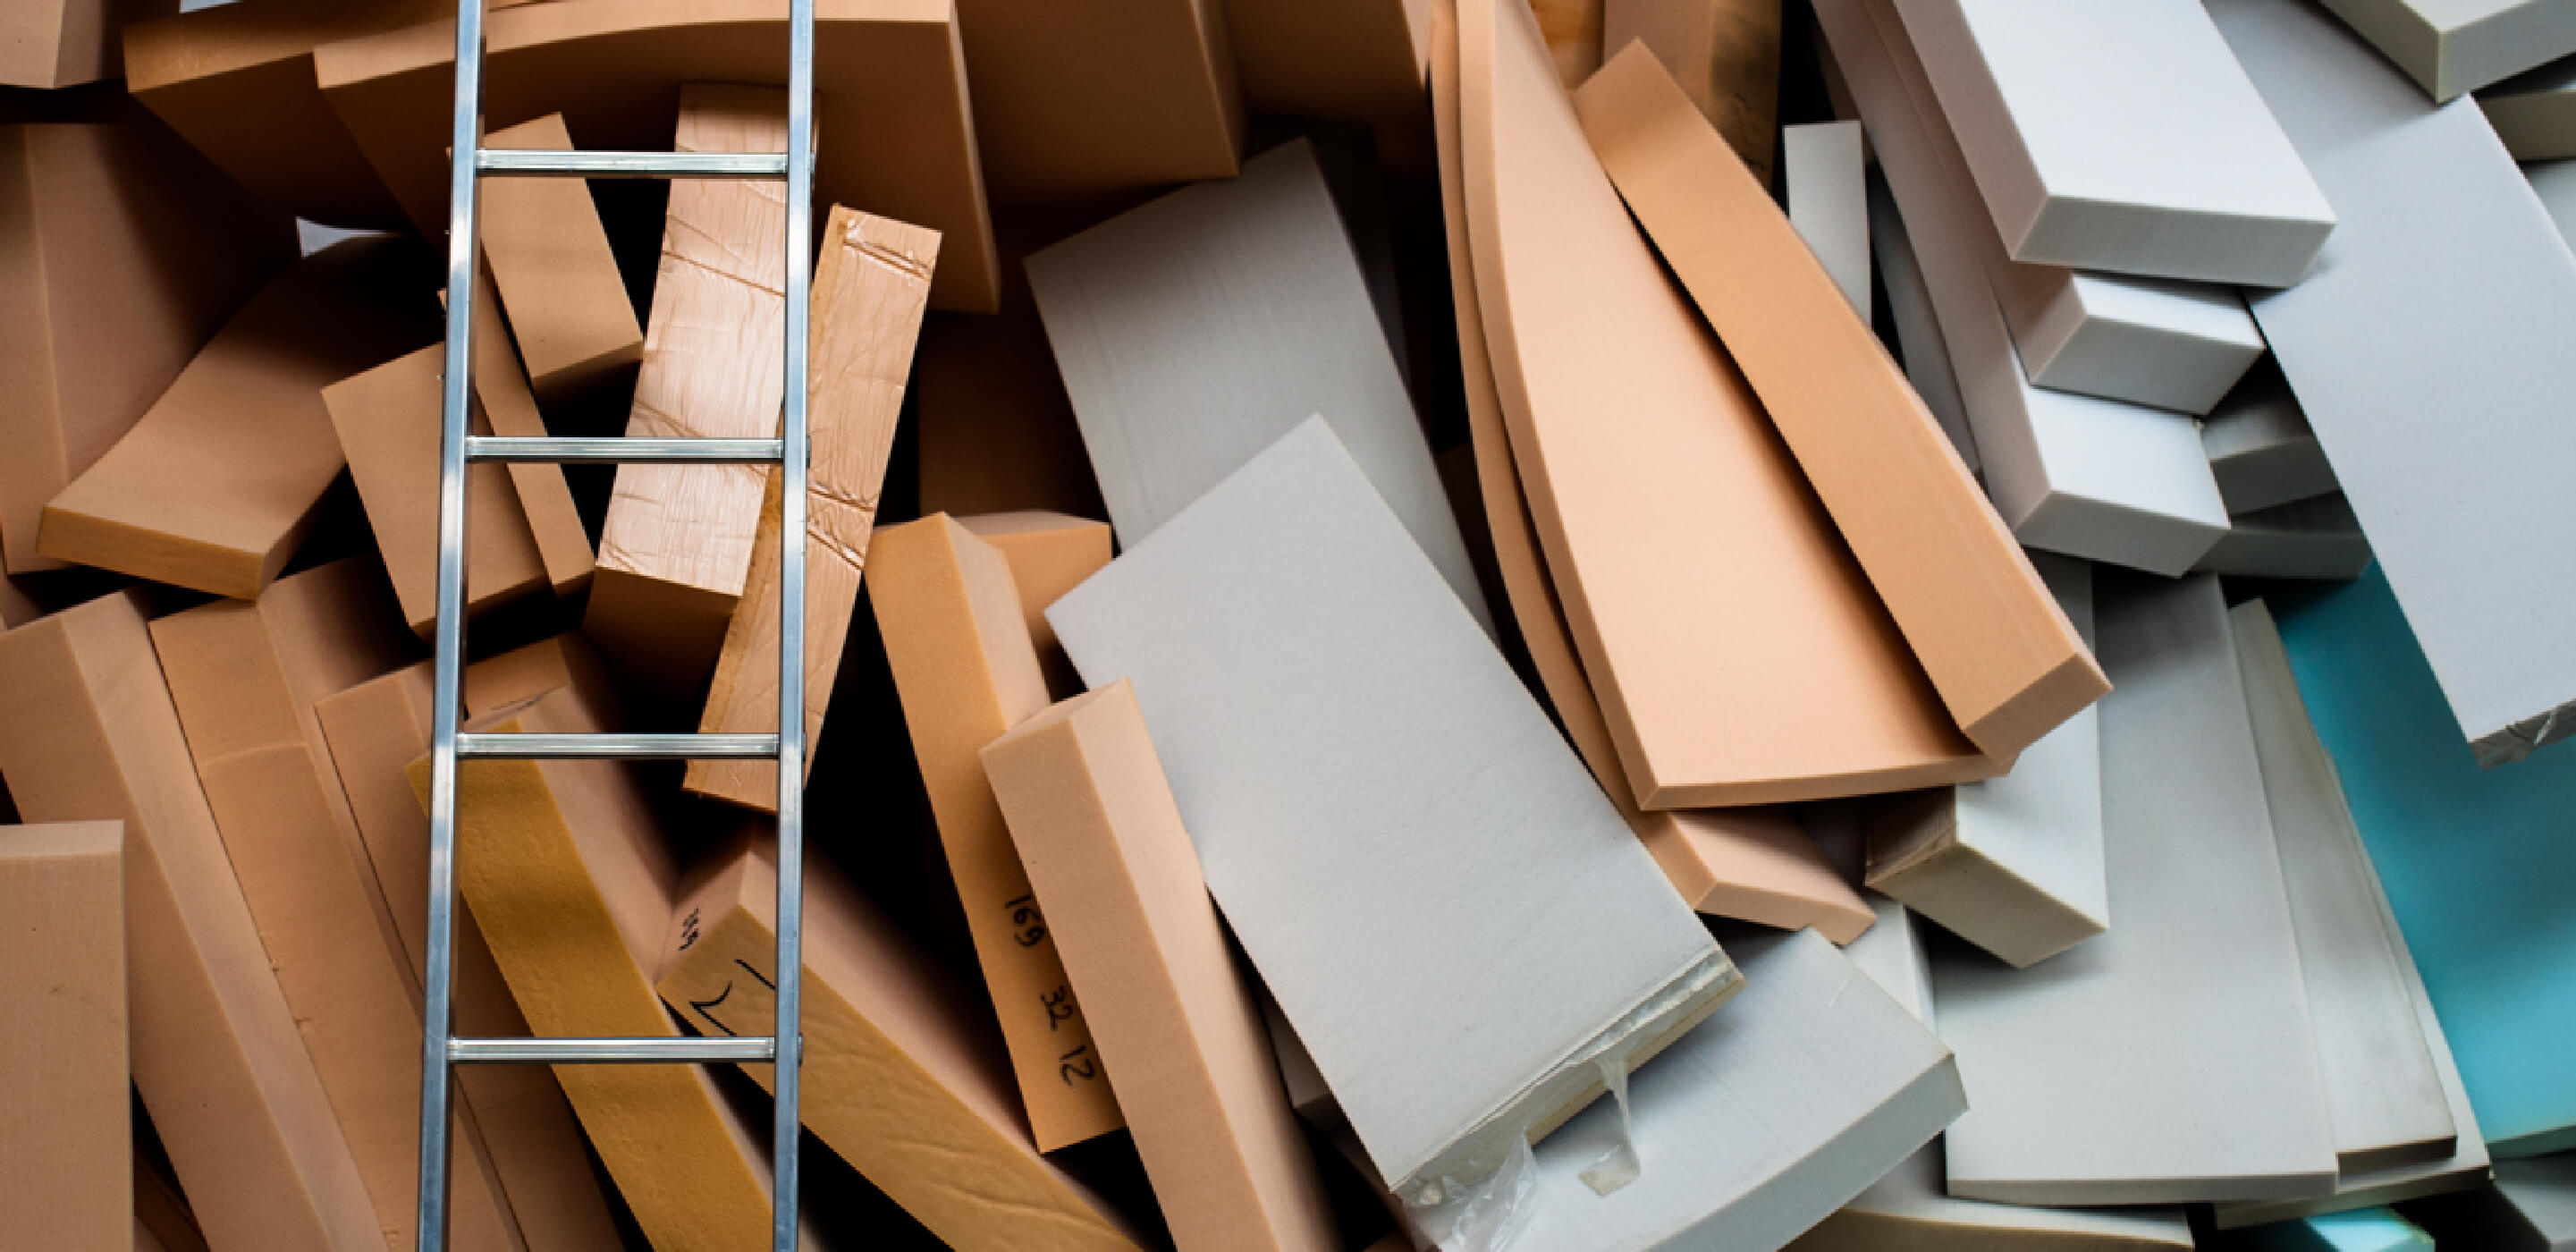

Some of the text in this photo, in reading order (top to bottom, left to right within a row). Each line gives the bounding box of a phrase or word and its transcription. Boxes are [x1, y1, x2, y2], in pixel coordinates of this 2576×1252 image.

[1003, 893, 1095, 1087] 169 32 12
